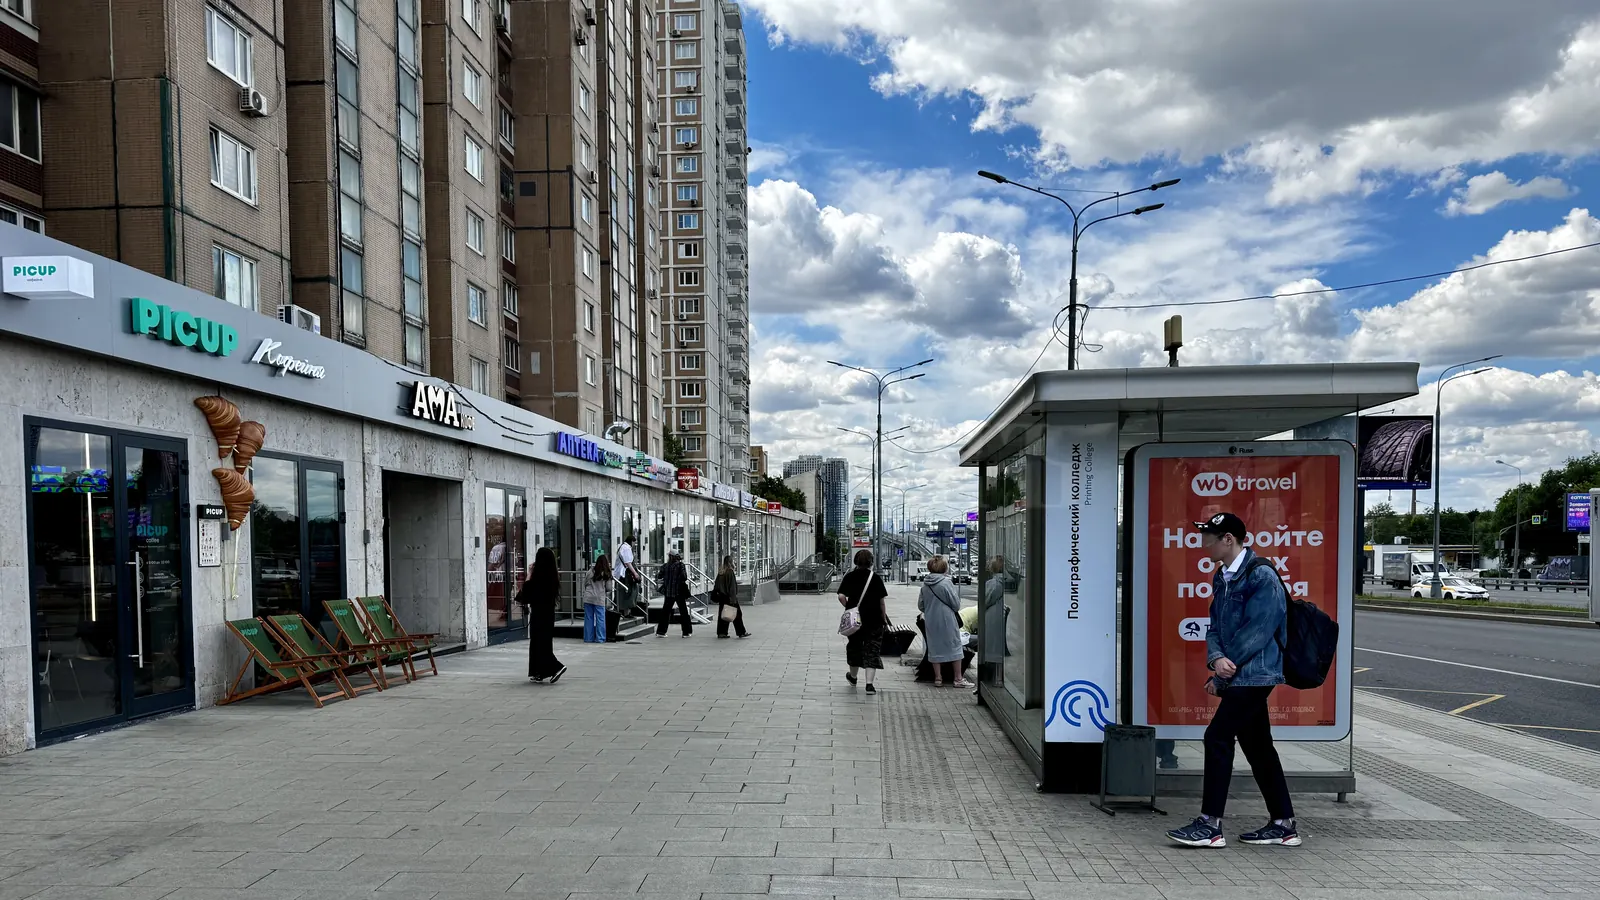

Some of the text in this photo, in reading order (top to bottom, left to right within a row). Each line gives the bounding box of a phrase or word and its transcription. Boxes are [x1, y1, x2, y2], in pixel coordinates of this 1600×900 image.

[13, 265, 56, 276] PICUP
[132, 297, 239, 357] PICUP
[251, 337, 326, 380] Кофейня
[558, 431, 599, 463] АПТЕКА
[1084, 442, 1095, 506] Printing College
[1235, 472, 1297, 491] travel
[136, 525, 168, 537] PICUP
[1067, 443, 1082, 619] Полиграфический колледж
